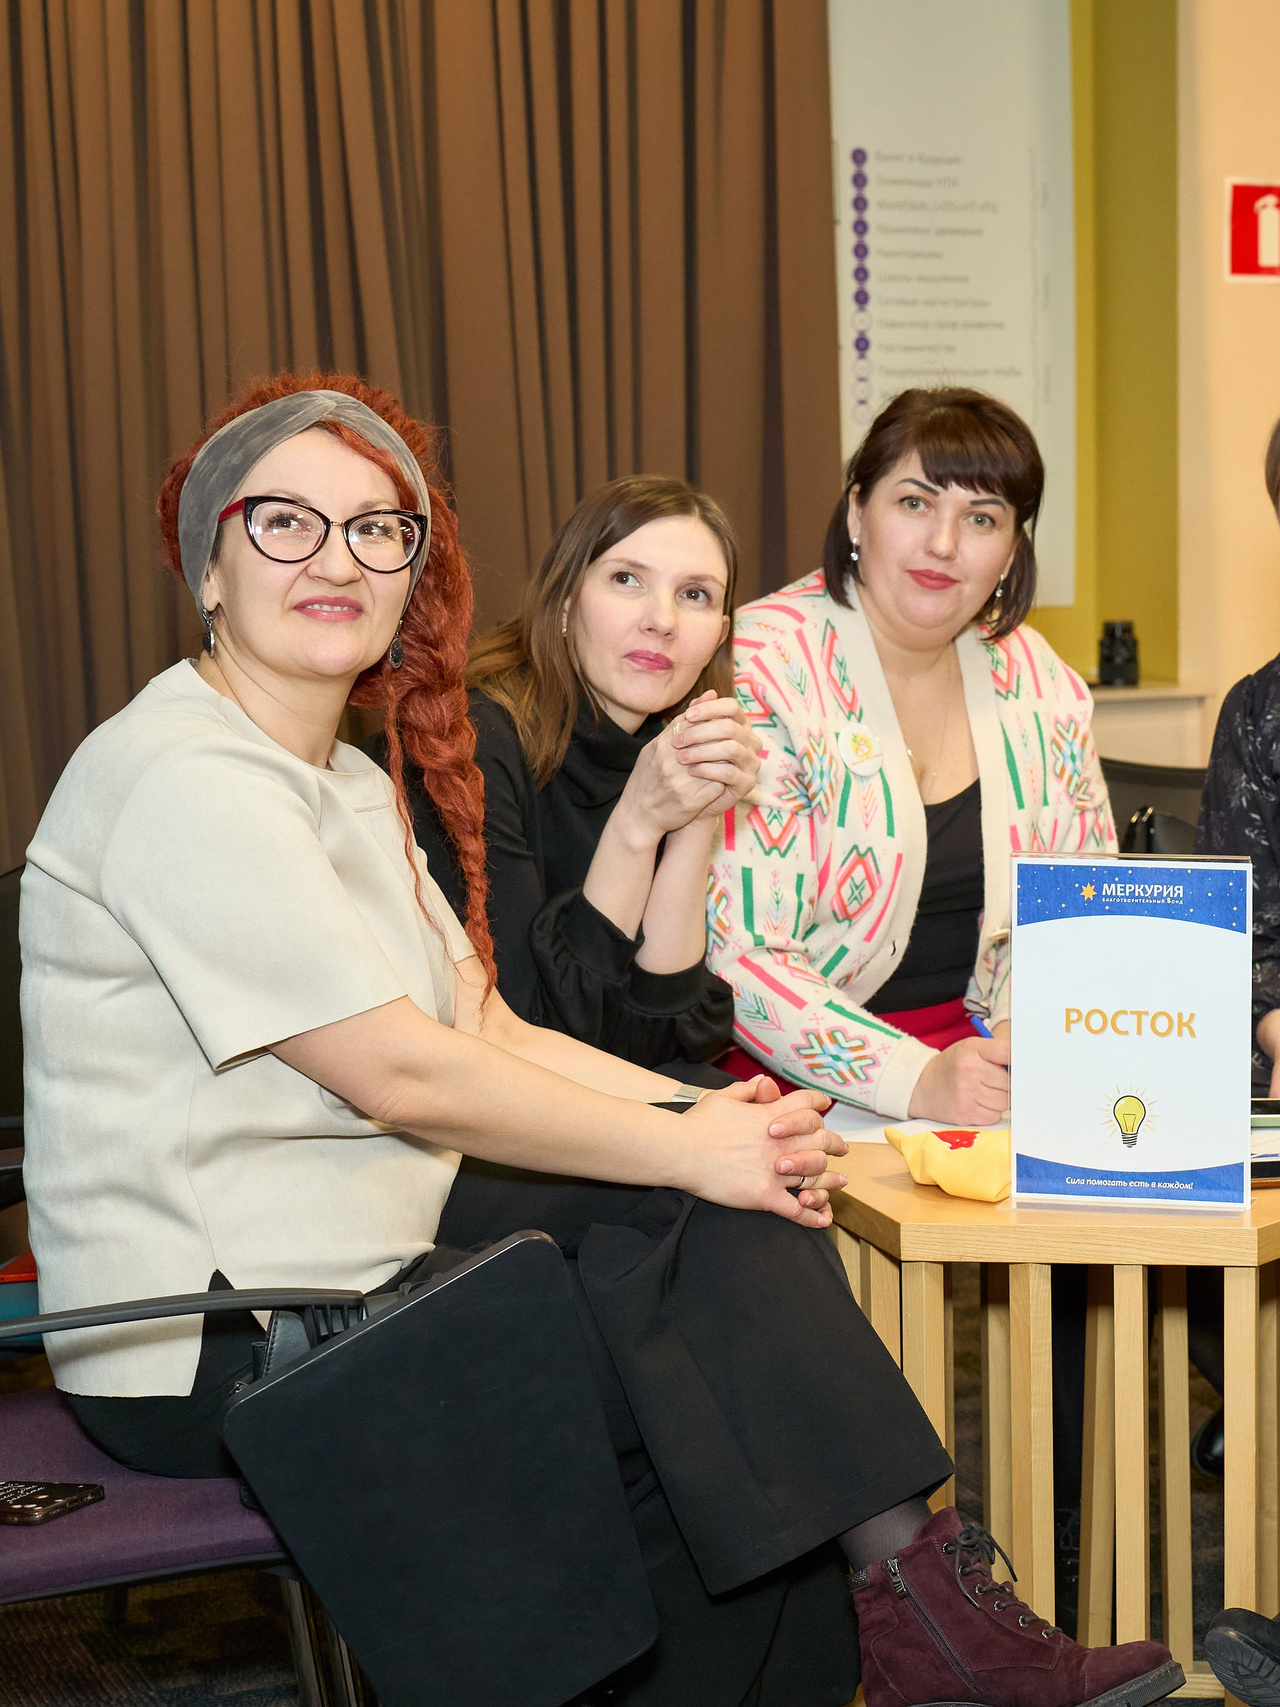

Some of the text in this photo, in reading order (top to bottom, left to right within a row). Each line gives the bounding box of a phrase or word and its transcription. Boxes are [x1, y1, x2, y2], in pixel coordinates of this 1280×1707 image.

[1102, 883, 1184, 898] МЕРКУРИЯ
[1065, 1008, 1196, 1038] РОСТОК
[1065, 1176, 1085, 1186] Сила
[1086, 1178, 1128, 1188] помогать
[1129, 1179, 1150, 1188] есть
[1157, 1180, 1194, 1190] каждом!
